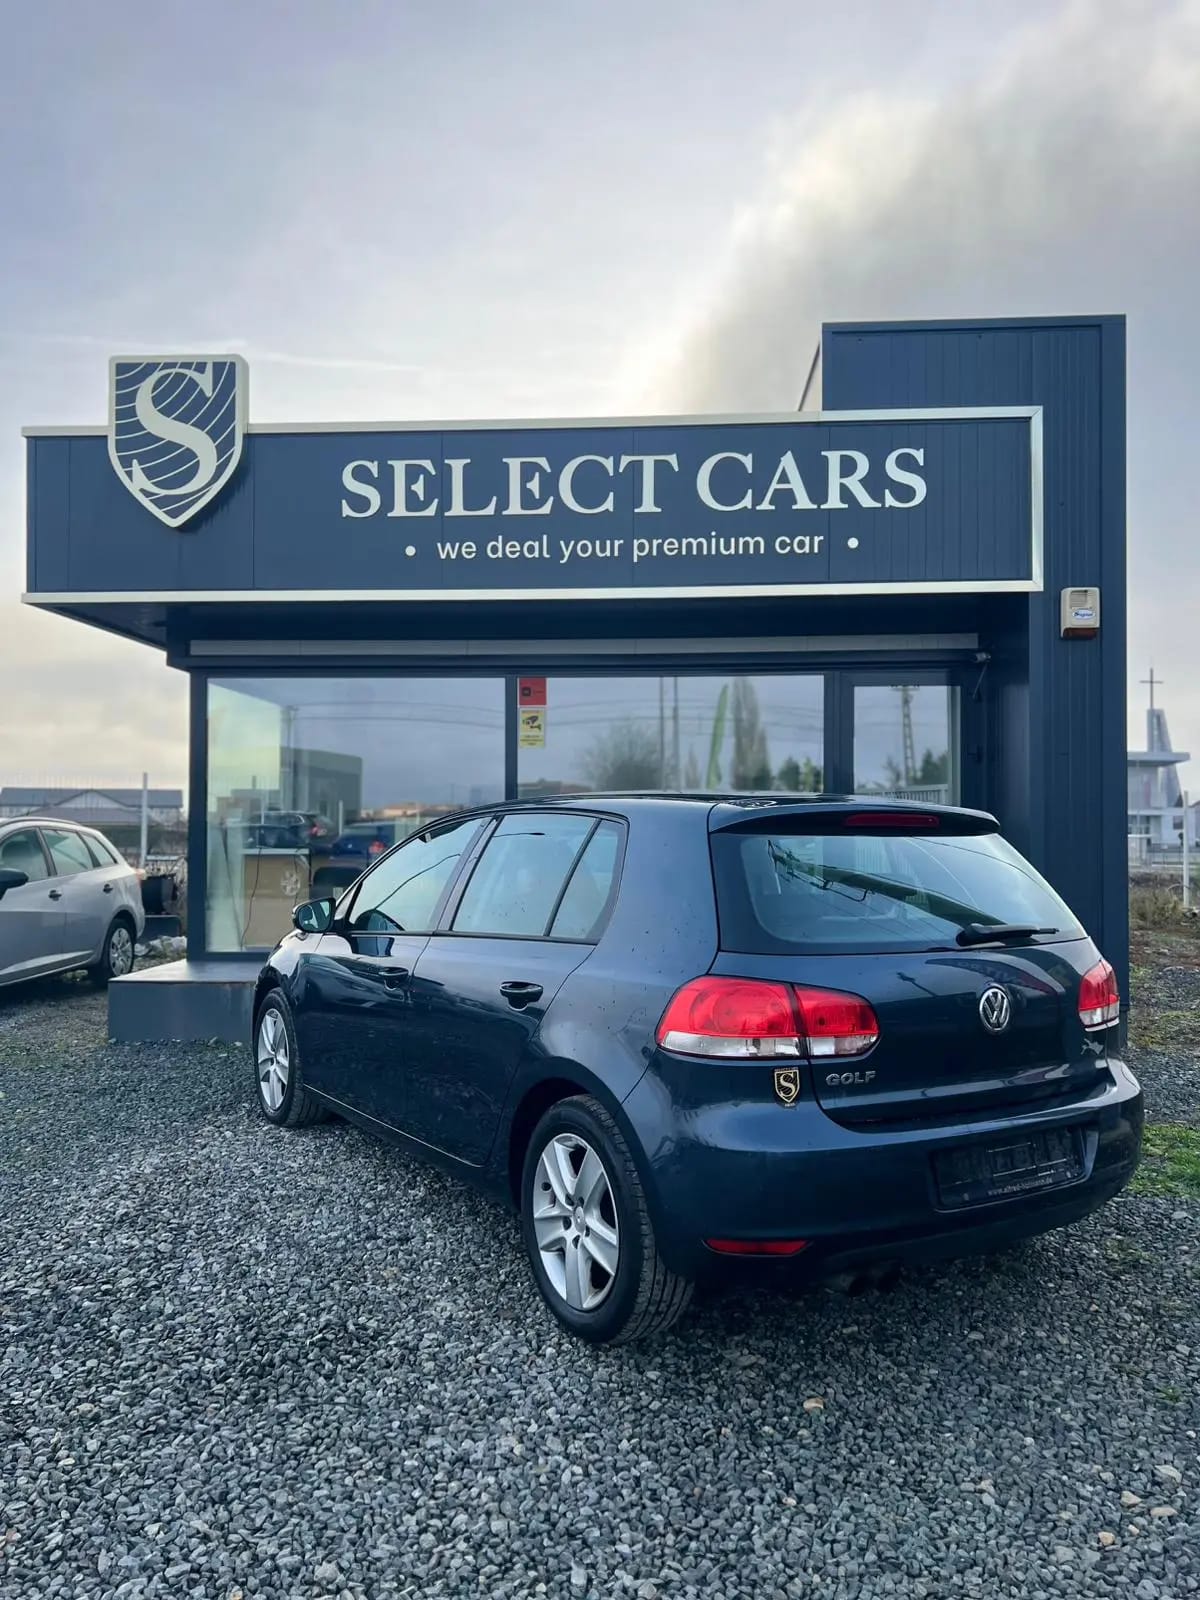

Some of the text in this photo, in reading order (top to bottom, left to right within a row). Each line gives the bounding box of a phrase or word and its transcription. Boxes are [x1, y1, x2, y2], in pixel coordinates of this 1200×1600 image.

[132, 361, 219, 496] S
[341, 447, 927, 518] SELECT CARS
[436, 531, 824, 563] we deal your premium car
[825, 1070, 876, 1087] GOLF
